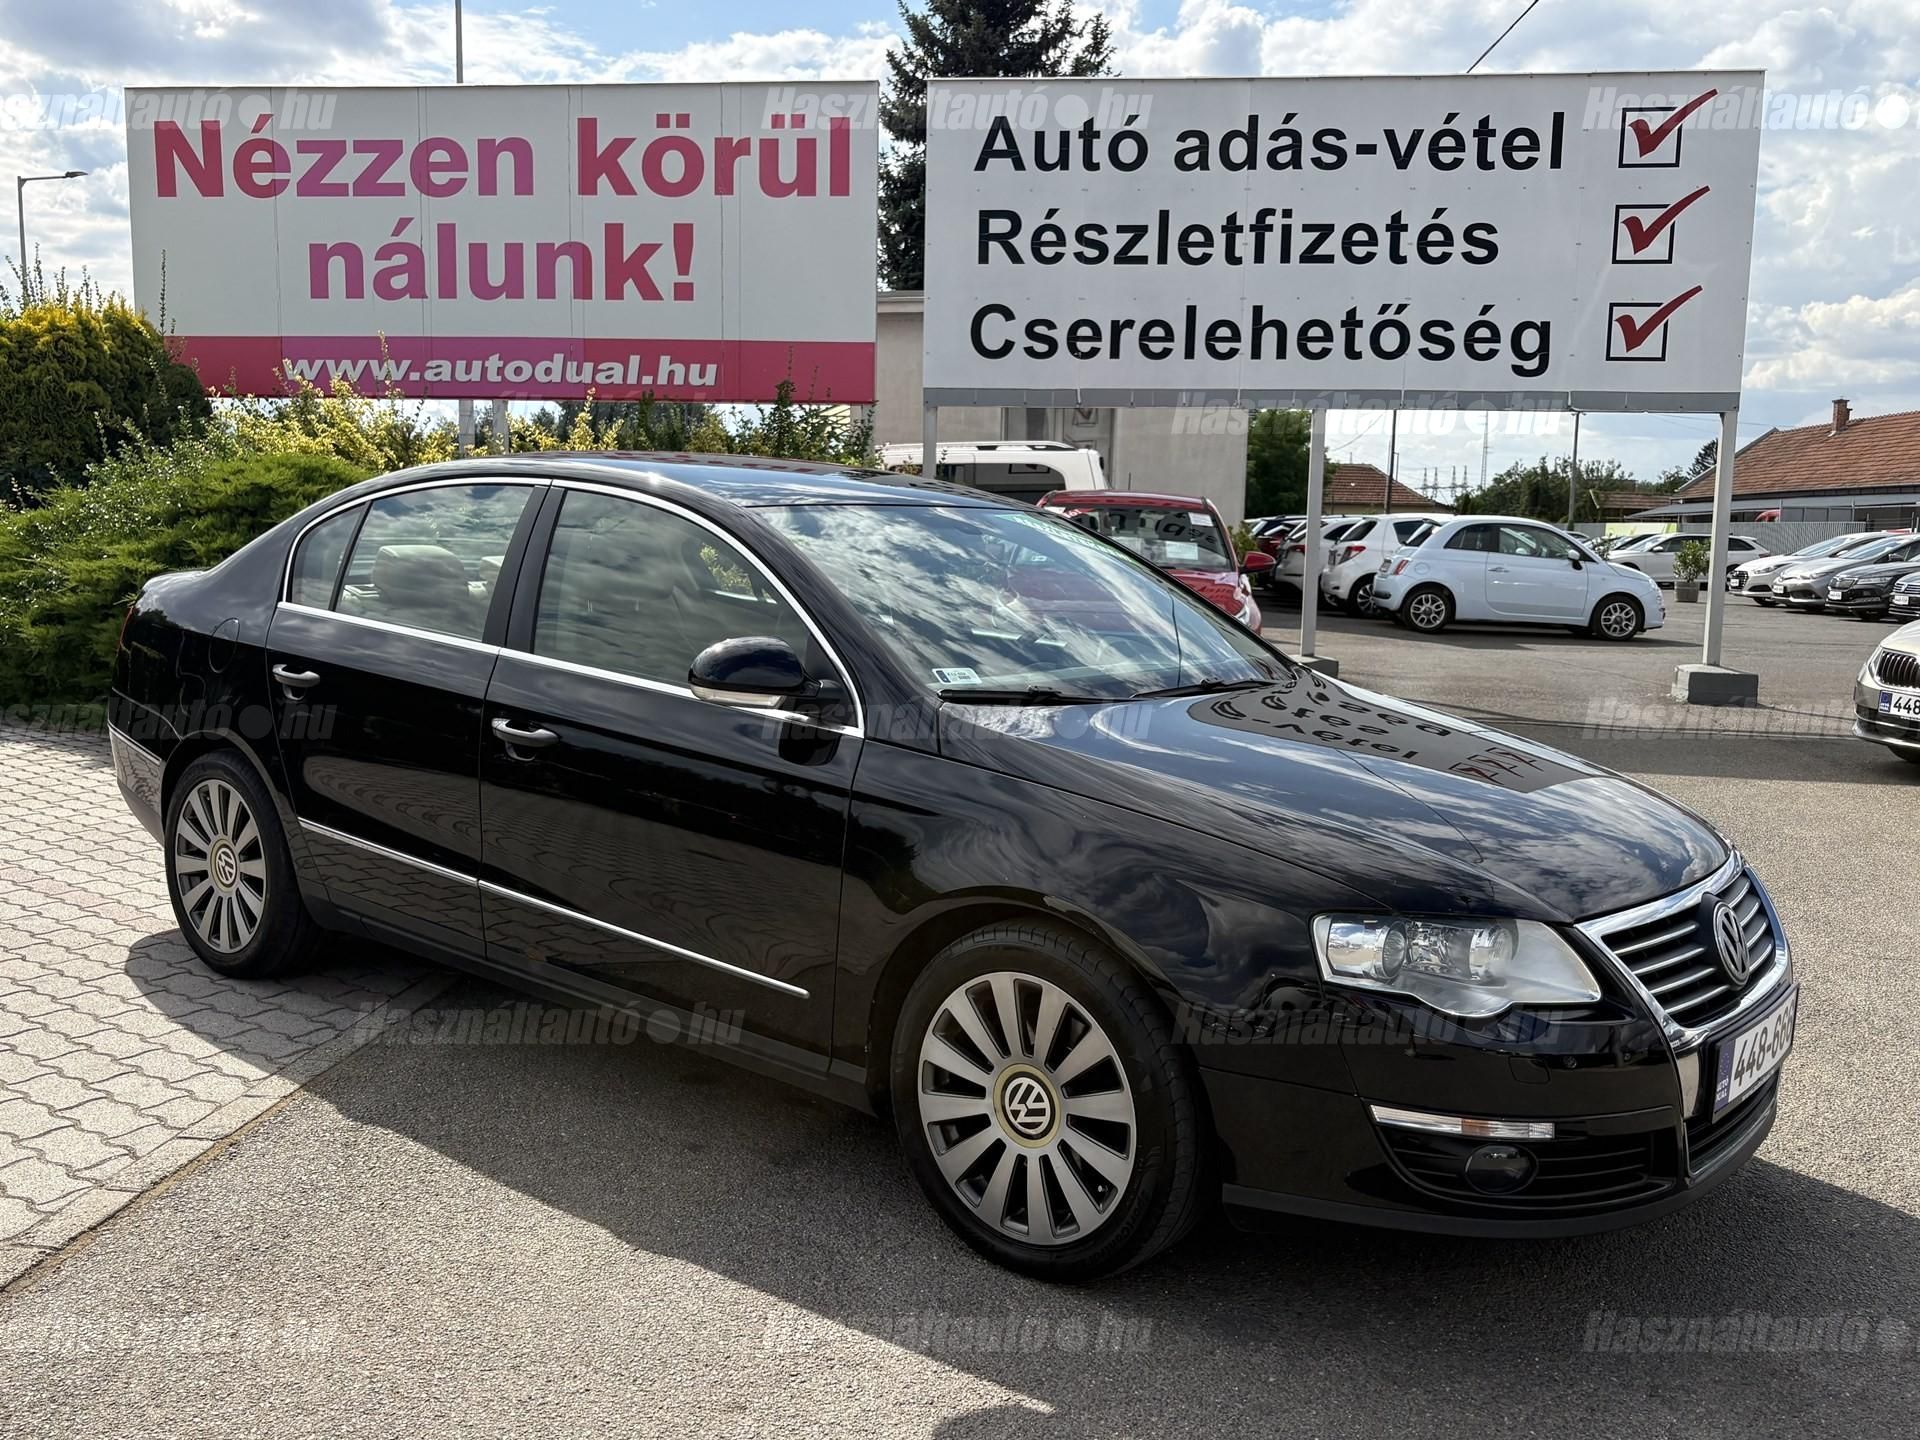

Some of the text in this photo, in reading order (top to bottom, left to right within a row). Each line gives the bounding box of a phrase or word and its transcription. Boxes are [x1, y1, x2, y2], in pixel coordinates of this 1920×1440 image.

[154, 113, 851, 198] Nézzen körül
[973, 111, 1565, 172] Autó adás-vétel
[309, 217, 695, 301] nálunk!
[977, 207, 1500, 266] Részletfizetés
[282, 352, 718, 388] www.autodual.hu
[970, 302, 1552, 378] Cserelehetőség
